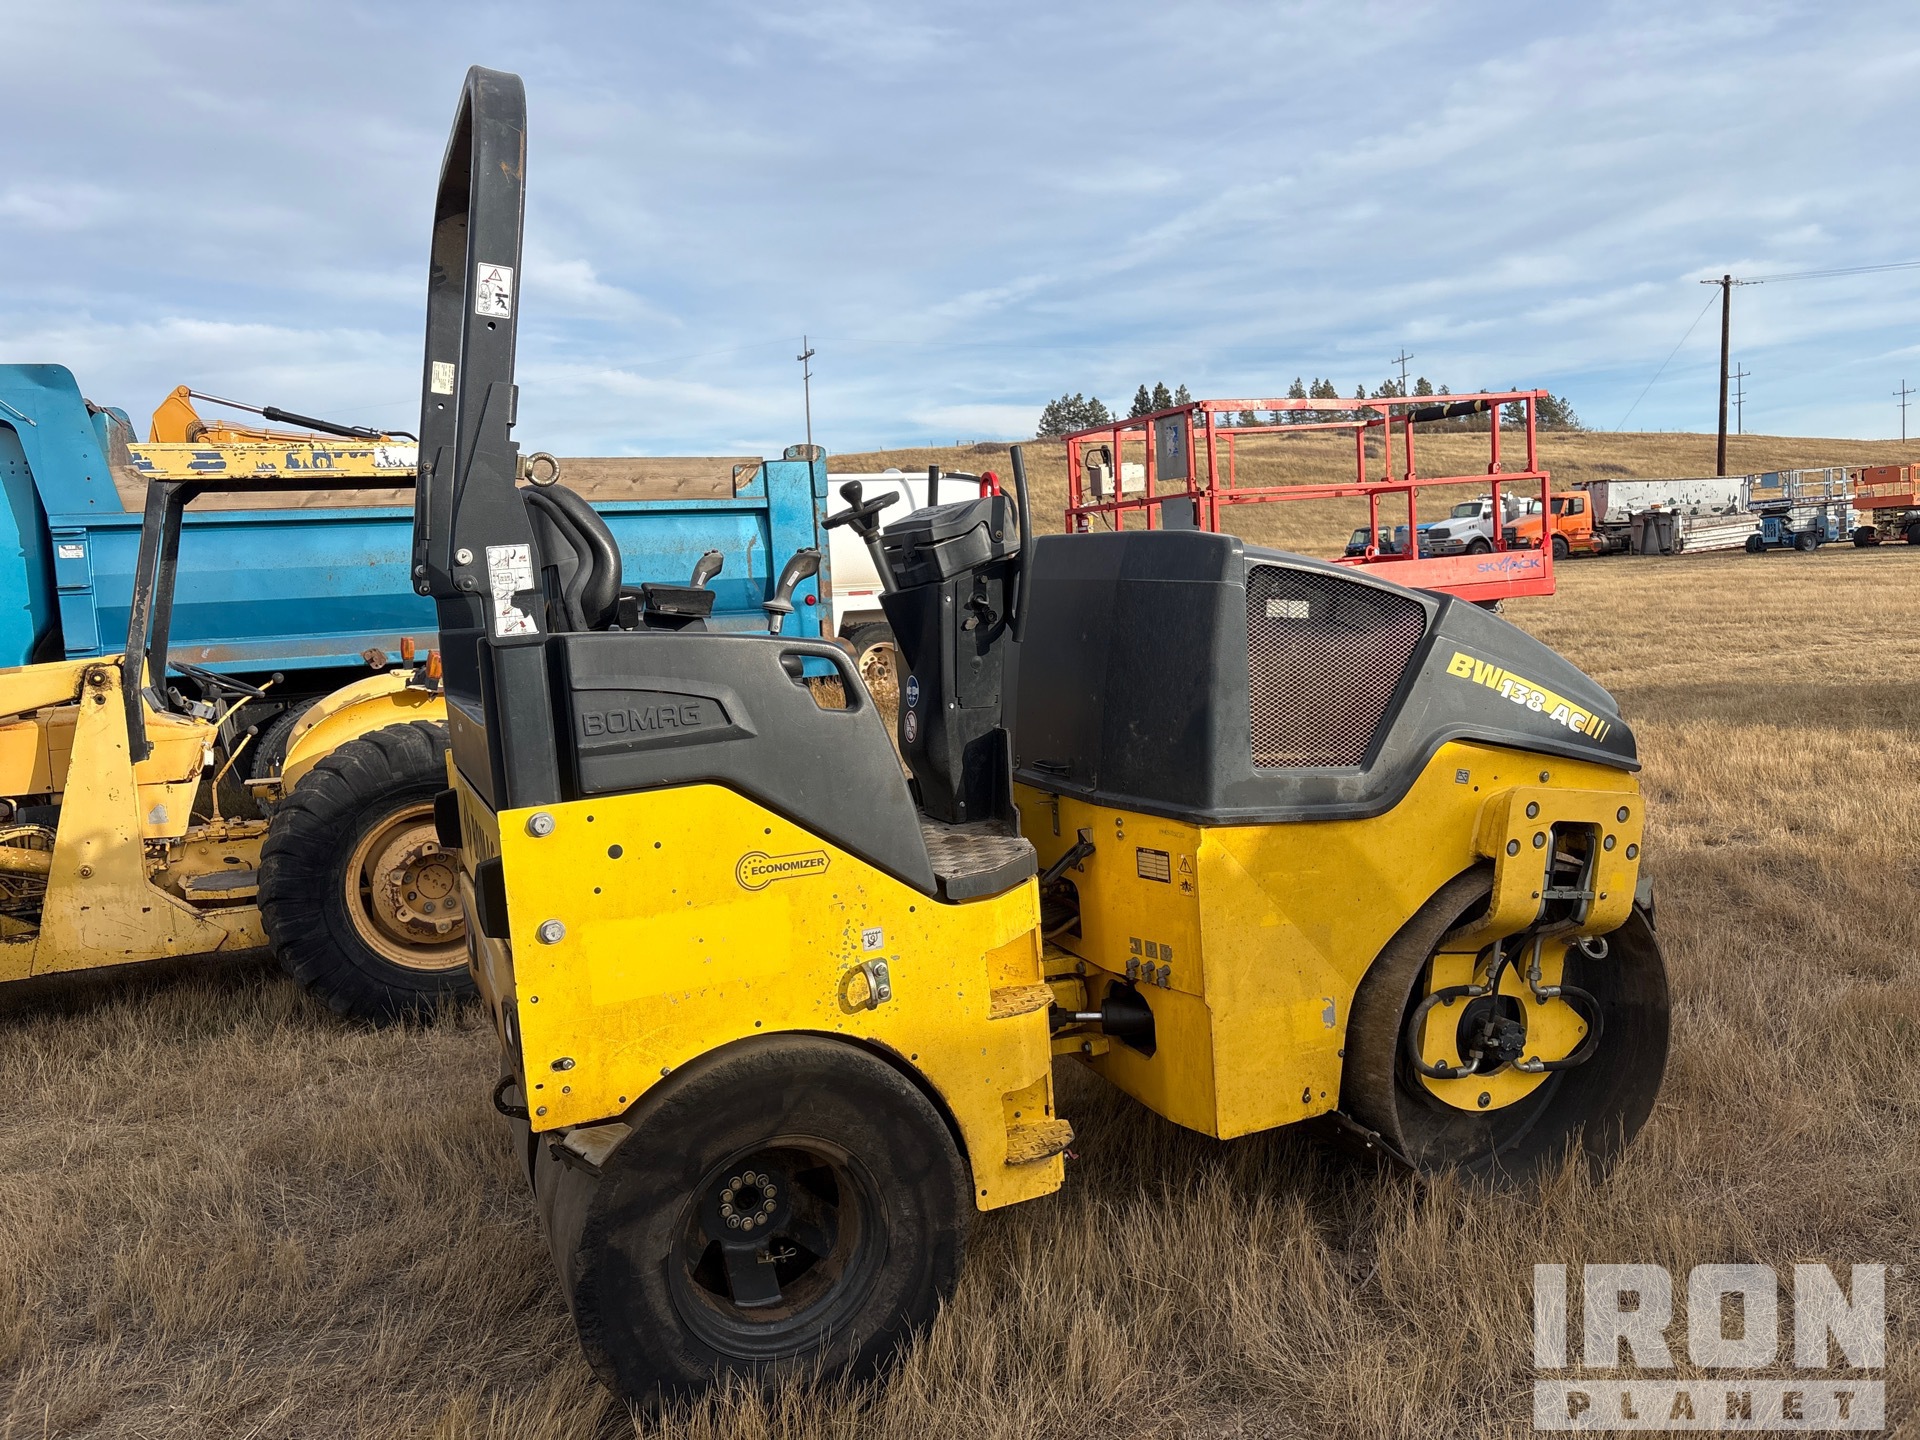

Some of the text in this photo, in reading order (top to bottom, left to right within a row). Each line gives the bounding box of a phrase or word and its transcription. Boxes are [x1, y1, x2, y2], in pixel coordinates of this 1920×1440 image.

[1477, 556, 1540, 572] SKYJACK
[1446, 651, 1587, 734] BW 138 AC
[582, 701, 702, 737] BOMAG
[751, 857, 825, 876] ECONOMIZER
